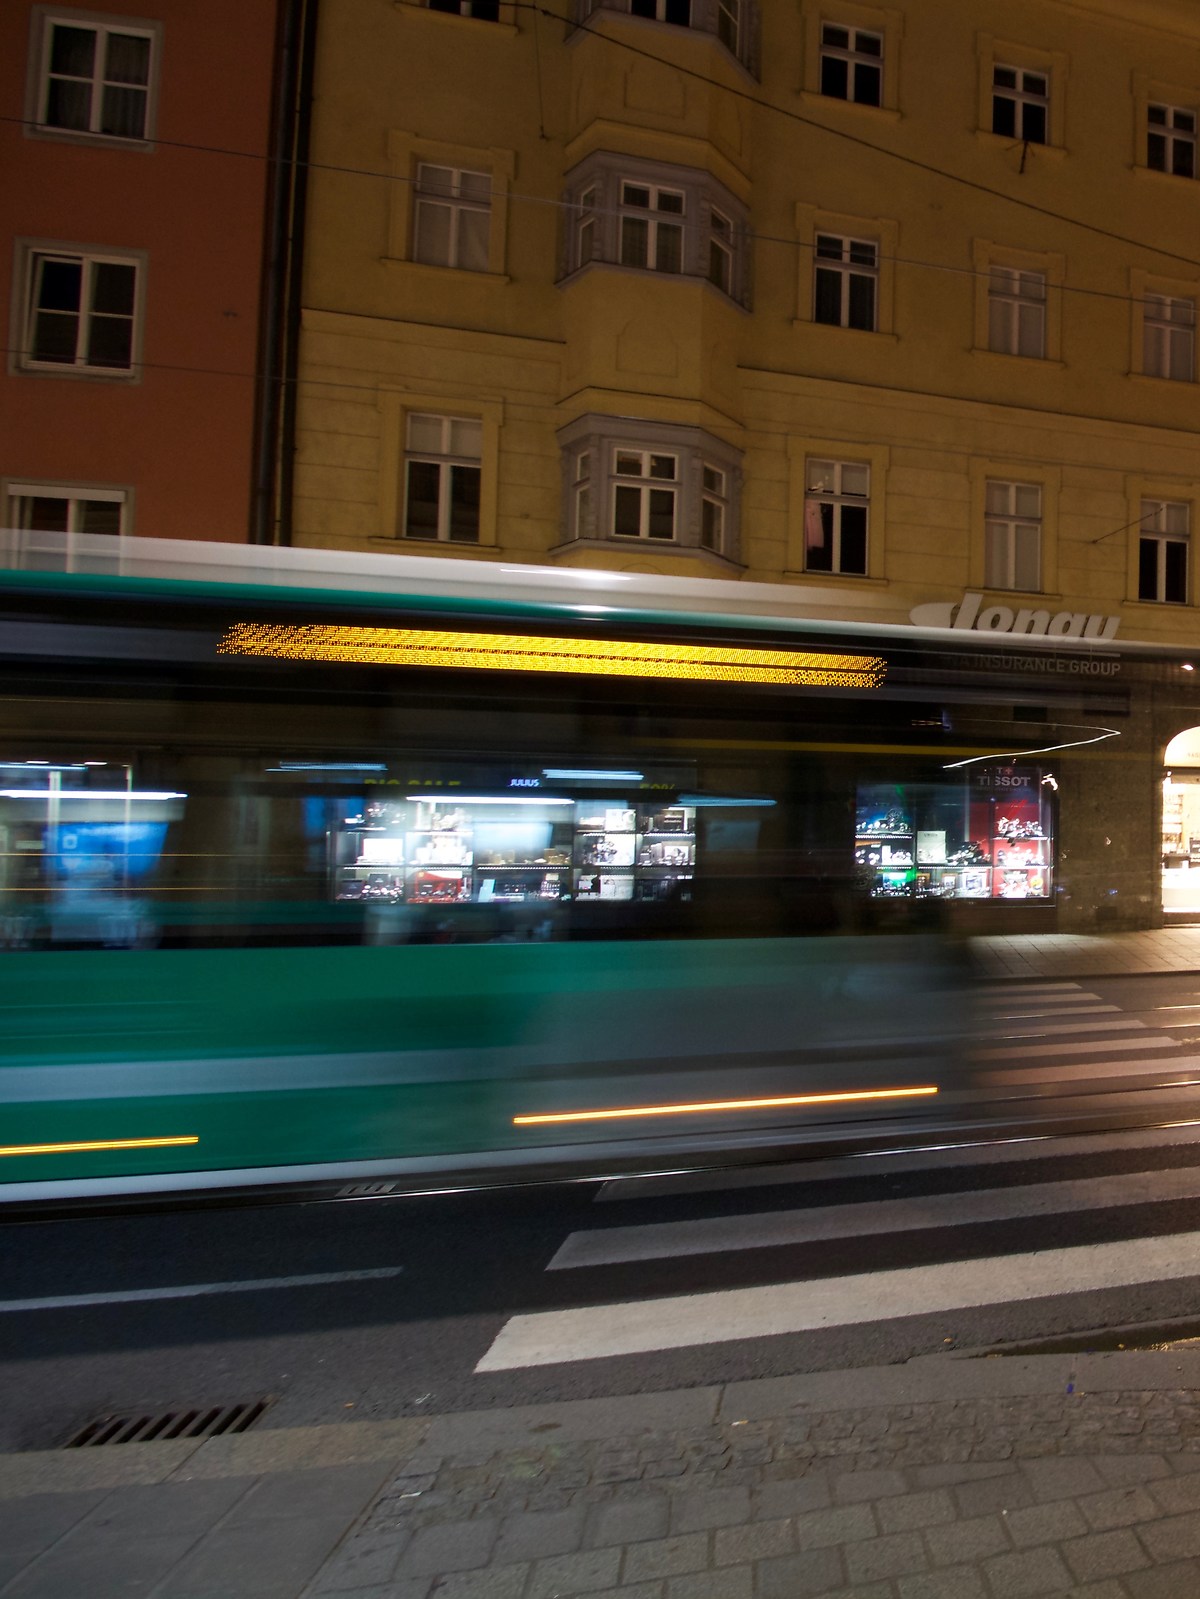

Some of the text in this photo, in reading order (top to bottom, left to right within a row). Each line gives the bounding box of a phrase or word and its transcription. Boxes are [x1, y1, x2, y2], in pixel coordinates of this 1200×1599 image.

[973, 655, 1066, 674] INSURANCE
[1069, 659, 1121, 677] GROUP
[976, 775, 1032, 787] TISSOT
